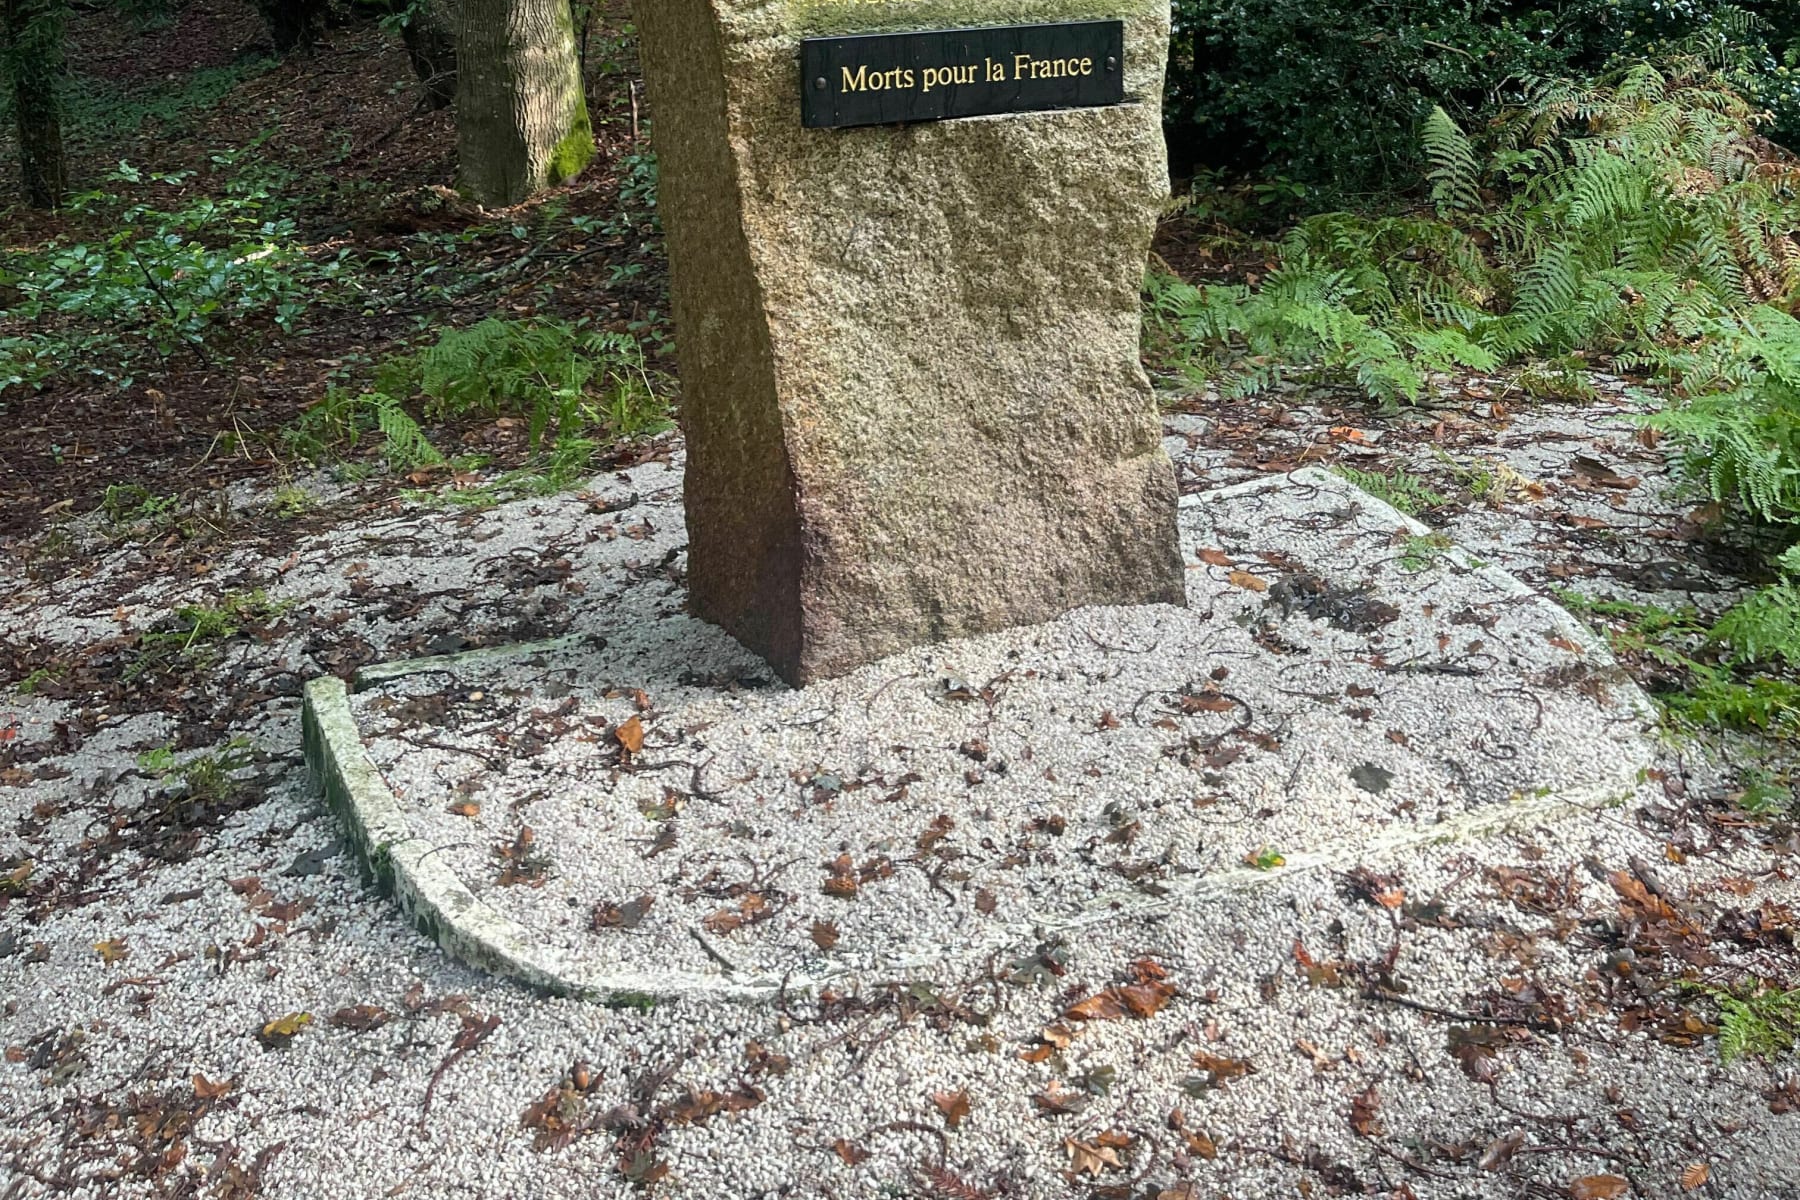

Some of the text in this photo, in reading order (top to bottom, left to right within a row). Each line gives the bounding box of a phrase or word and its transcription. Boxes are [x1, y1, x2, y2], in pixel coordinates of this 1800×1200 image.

[840, 54, 1093, 94] Morts pour la France
